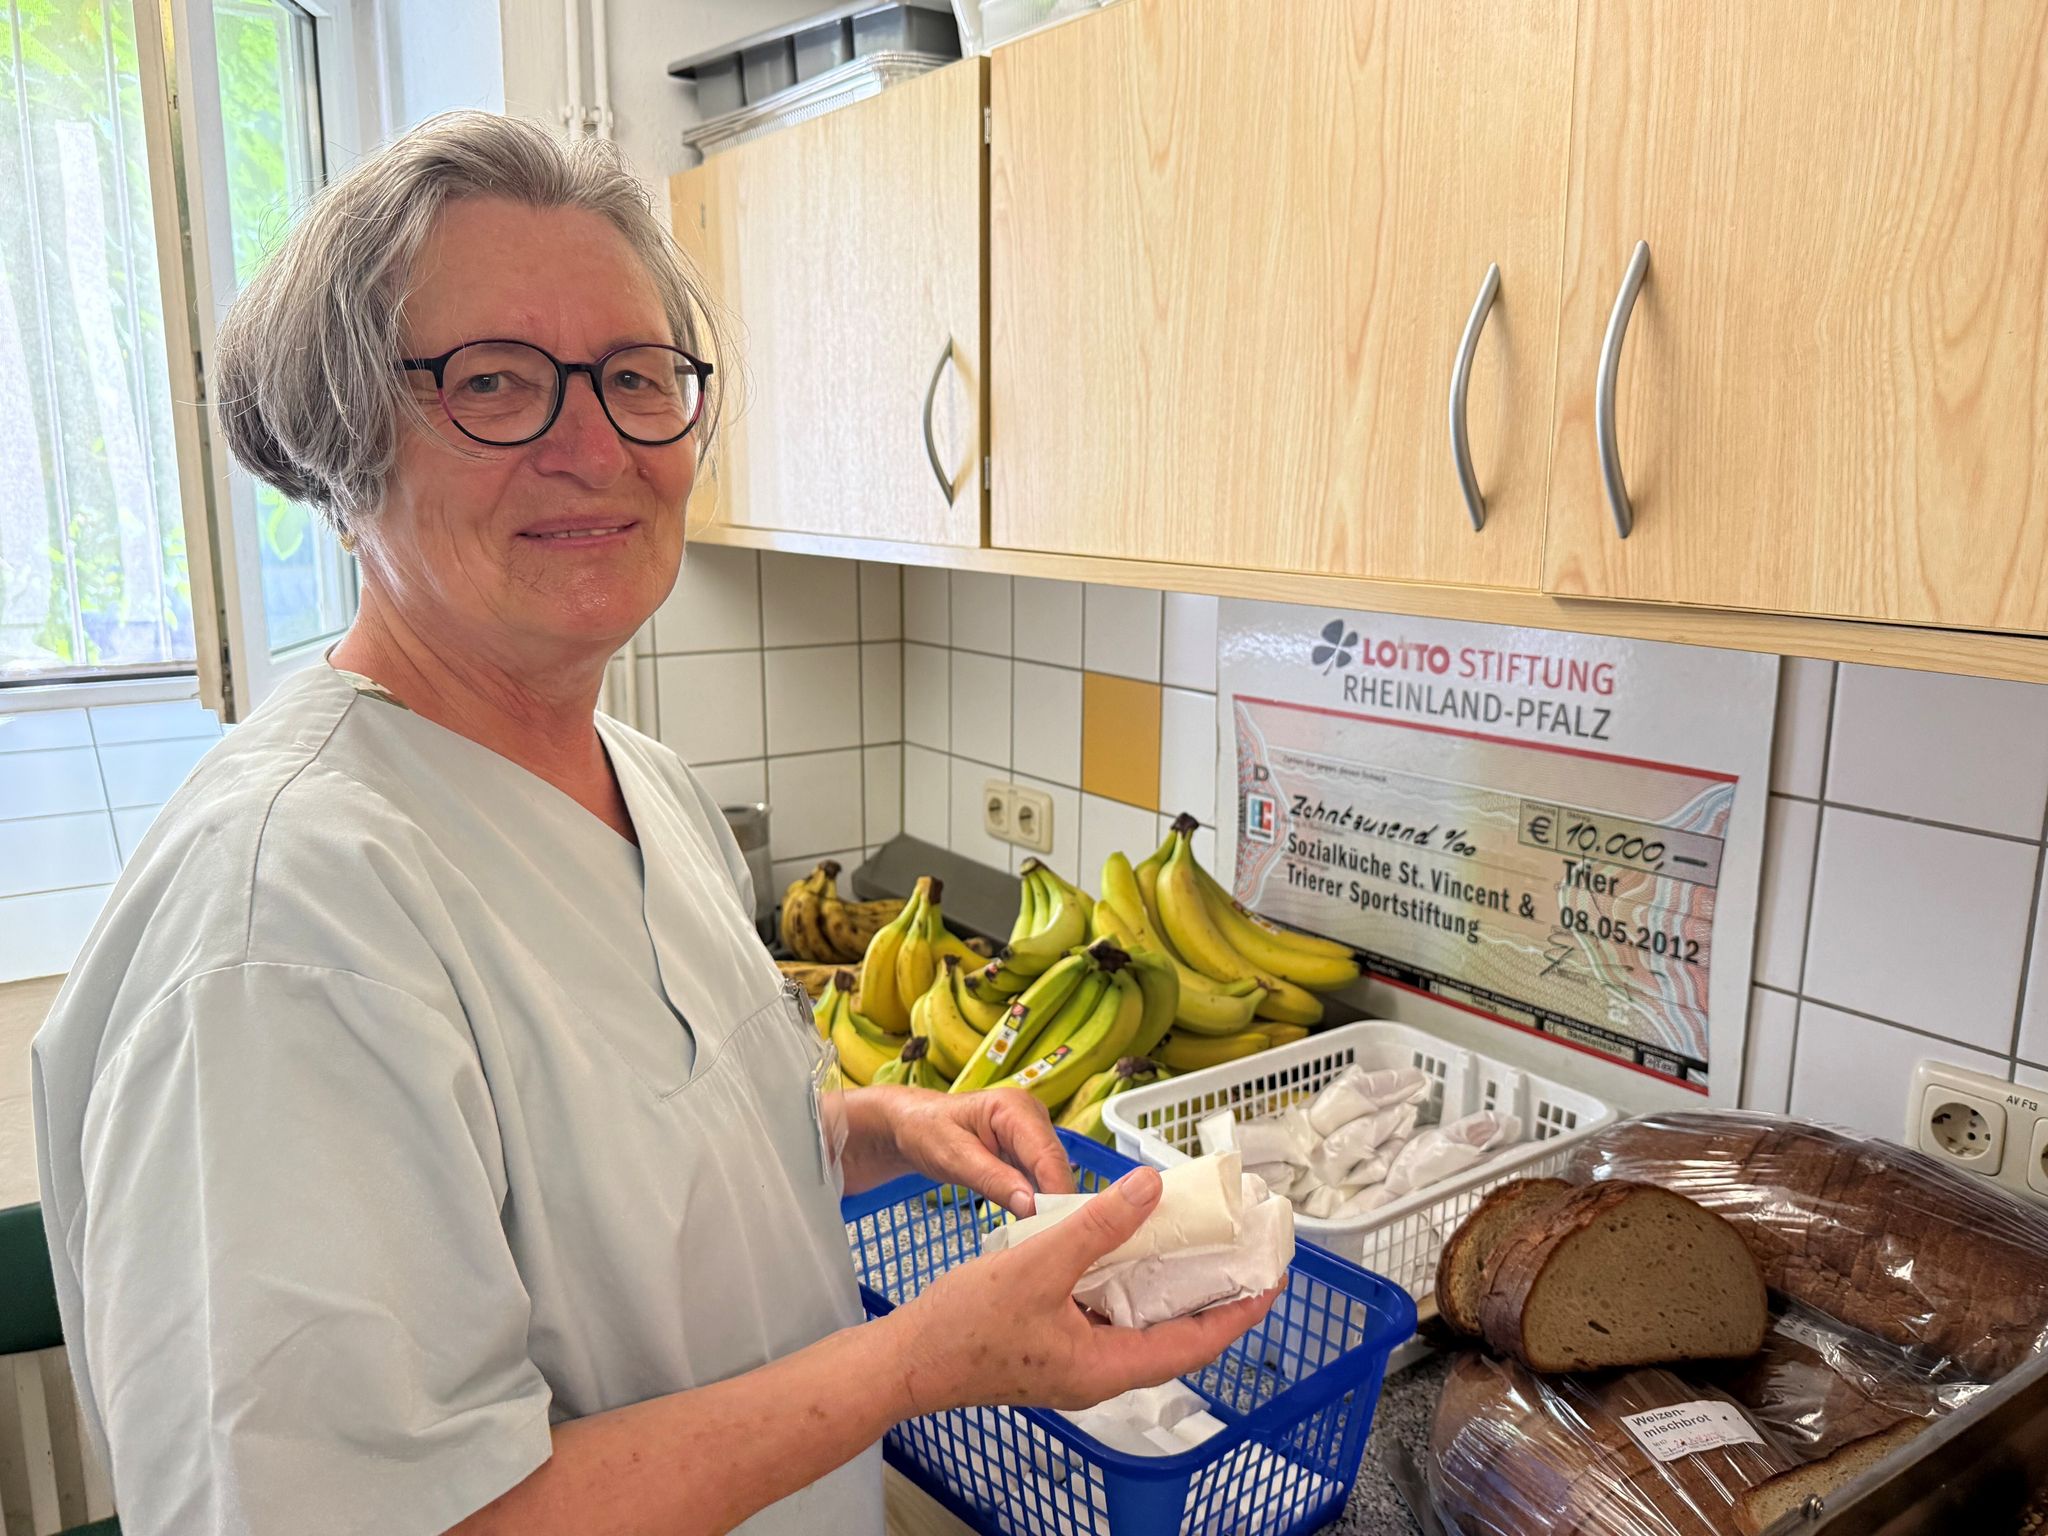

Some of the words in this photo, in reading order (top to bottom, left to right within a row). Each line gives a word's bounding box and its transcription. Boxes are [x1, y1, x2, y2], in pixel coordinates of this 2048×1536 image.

[1363, 638, 1450, 674] LOTTO
[1459, 648, 1615, 695] STIFTUNG
[1343, 675, 1611, 740] RHEINLAND-PFALZ
[1253, 764, 1269, 781] D
[1290, 795, 1439, 845] Zehntausend
[1527, 815, 1552, 844] €
[1287, 832, 1392, 880] Sozialküche
[1398, 861, 1423, 889] St.
[1431, 868, 1510, 913] Vincent
[1519, 892, 1536, 919] &
[1562, 859, 1620, 896] Trier
[1286, 863, 1344, 897] Trierer
[1349, 881, 1480, 944] Sportstiftung
[1560, 906, 1700, 964] 08.05.2012
[1631, 1408, 1686, 1427] Weizen-
[1643, 1413, 1713, 1438] mischbrot
